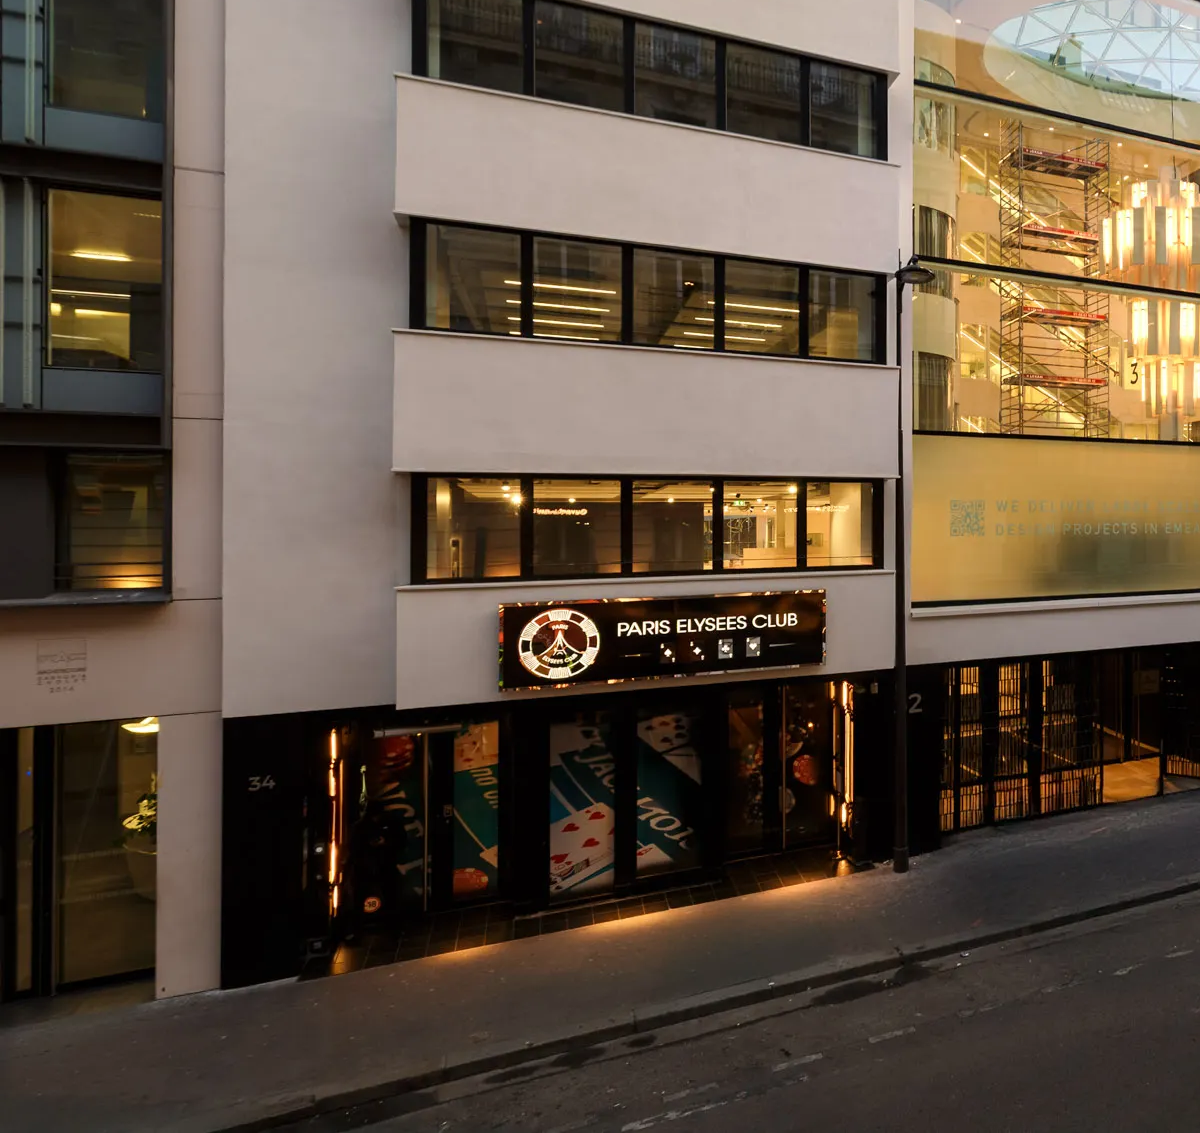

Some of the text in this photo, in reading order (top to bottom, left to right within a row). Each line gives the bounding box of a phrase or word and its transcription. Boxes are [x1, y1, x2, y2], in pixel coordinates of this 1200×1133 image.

[1130, 362, 1139, 385] 3
[996, 500, 1020, 513] WE
[1028, 499, 1095, 513] DELIVER
[996, 523, 1056, 536] DESIGN
[1062, 522, 1138, 536] PROJECTS
[1144, 522, 1158, 535] IN
[617, 612, 798, 637] PARIS ELYSEES CLUB
[541, 655, 563, 664] ELYSEES
[908, 693, 923, 714] 2
[247, 774, 276, 792] 34
